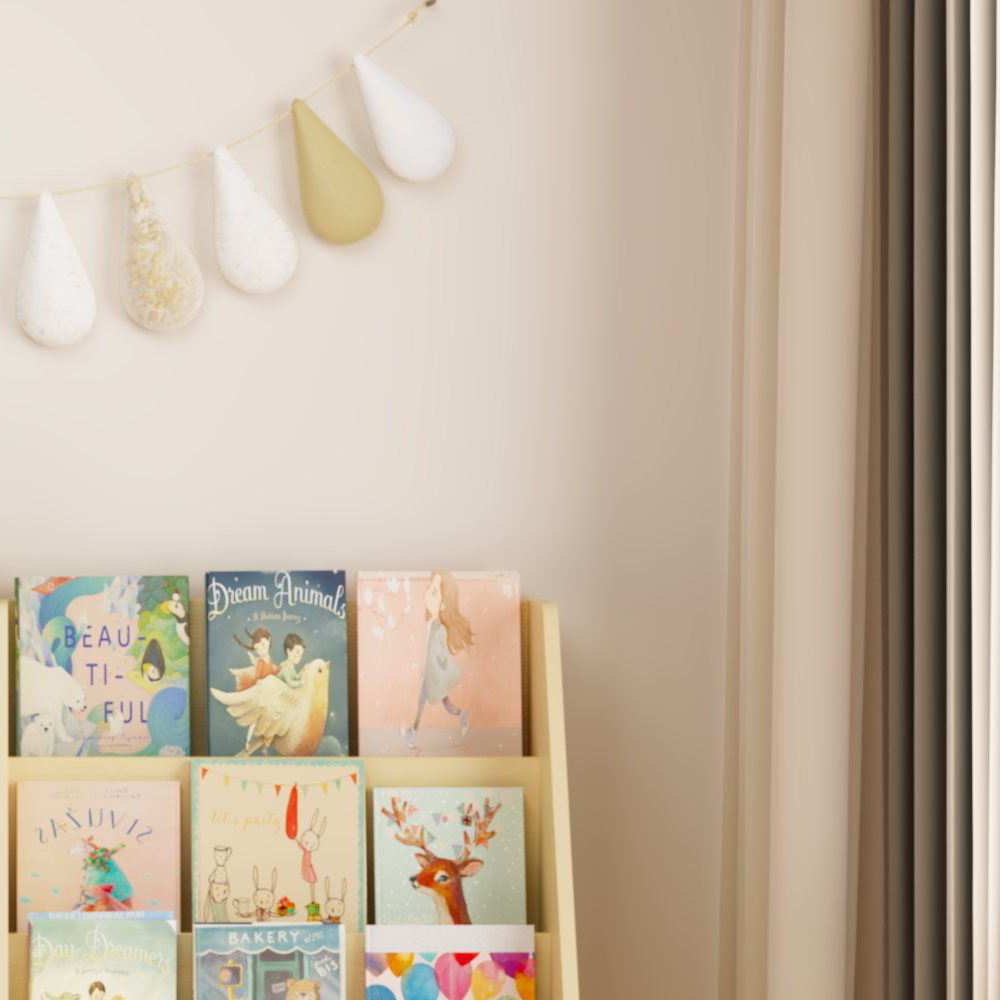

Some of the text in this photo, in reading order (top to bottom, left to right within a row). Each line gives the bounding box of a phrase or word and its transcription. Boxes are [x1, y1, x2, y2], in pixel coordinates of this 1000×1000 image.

[207, 570, 346, 622] Dream Animals
[64, 625, 146, 648] BEAU-
[85, 663, 123, 685] TI-
[104, 701, 148, 723] FUL
[211, 809, 282, 836] let's party
[32, 925, 171, 973] Day Dreamers
[228, 930, 300, 945] BAKERY
